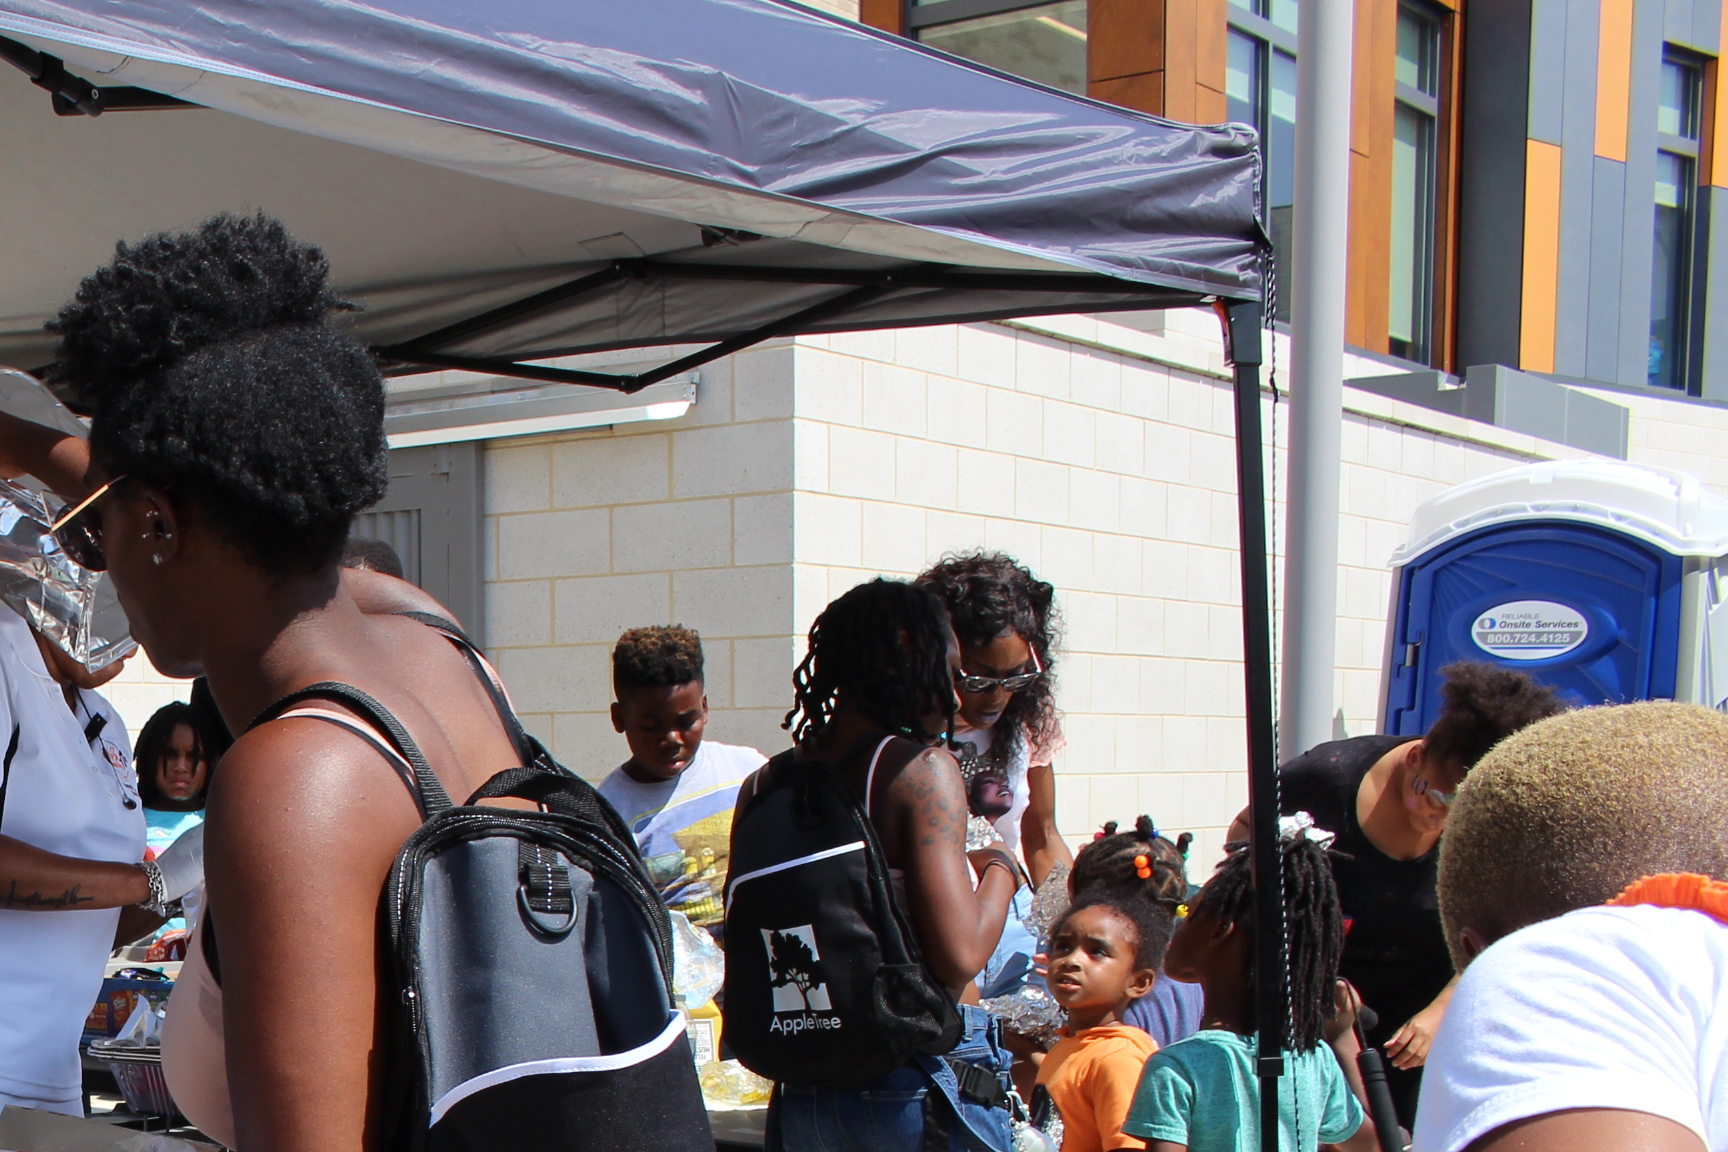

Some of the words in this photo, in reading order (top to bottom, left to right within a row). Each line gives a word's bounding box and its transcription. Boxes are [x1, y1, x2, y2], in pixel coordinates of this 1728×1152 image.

[1501, 612, 1540, 620] RELIABLE
[1498, 620, 1532, 629] Onsite
[1534, 620, 1580, 629] Services
[1486, 632, 1571, 644] 800.724.4125
[769, 1013, 842, 1036] AppleTree
